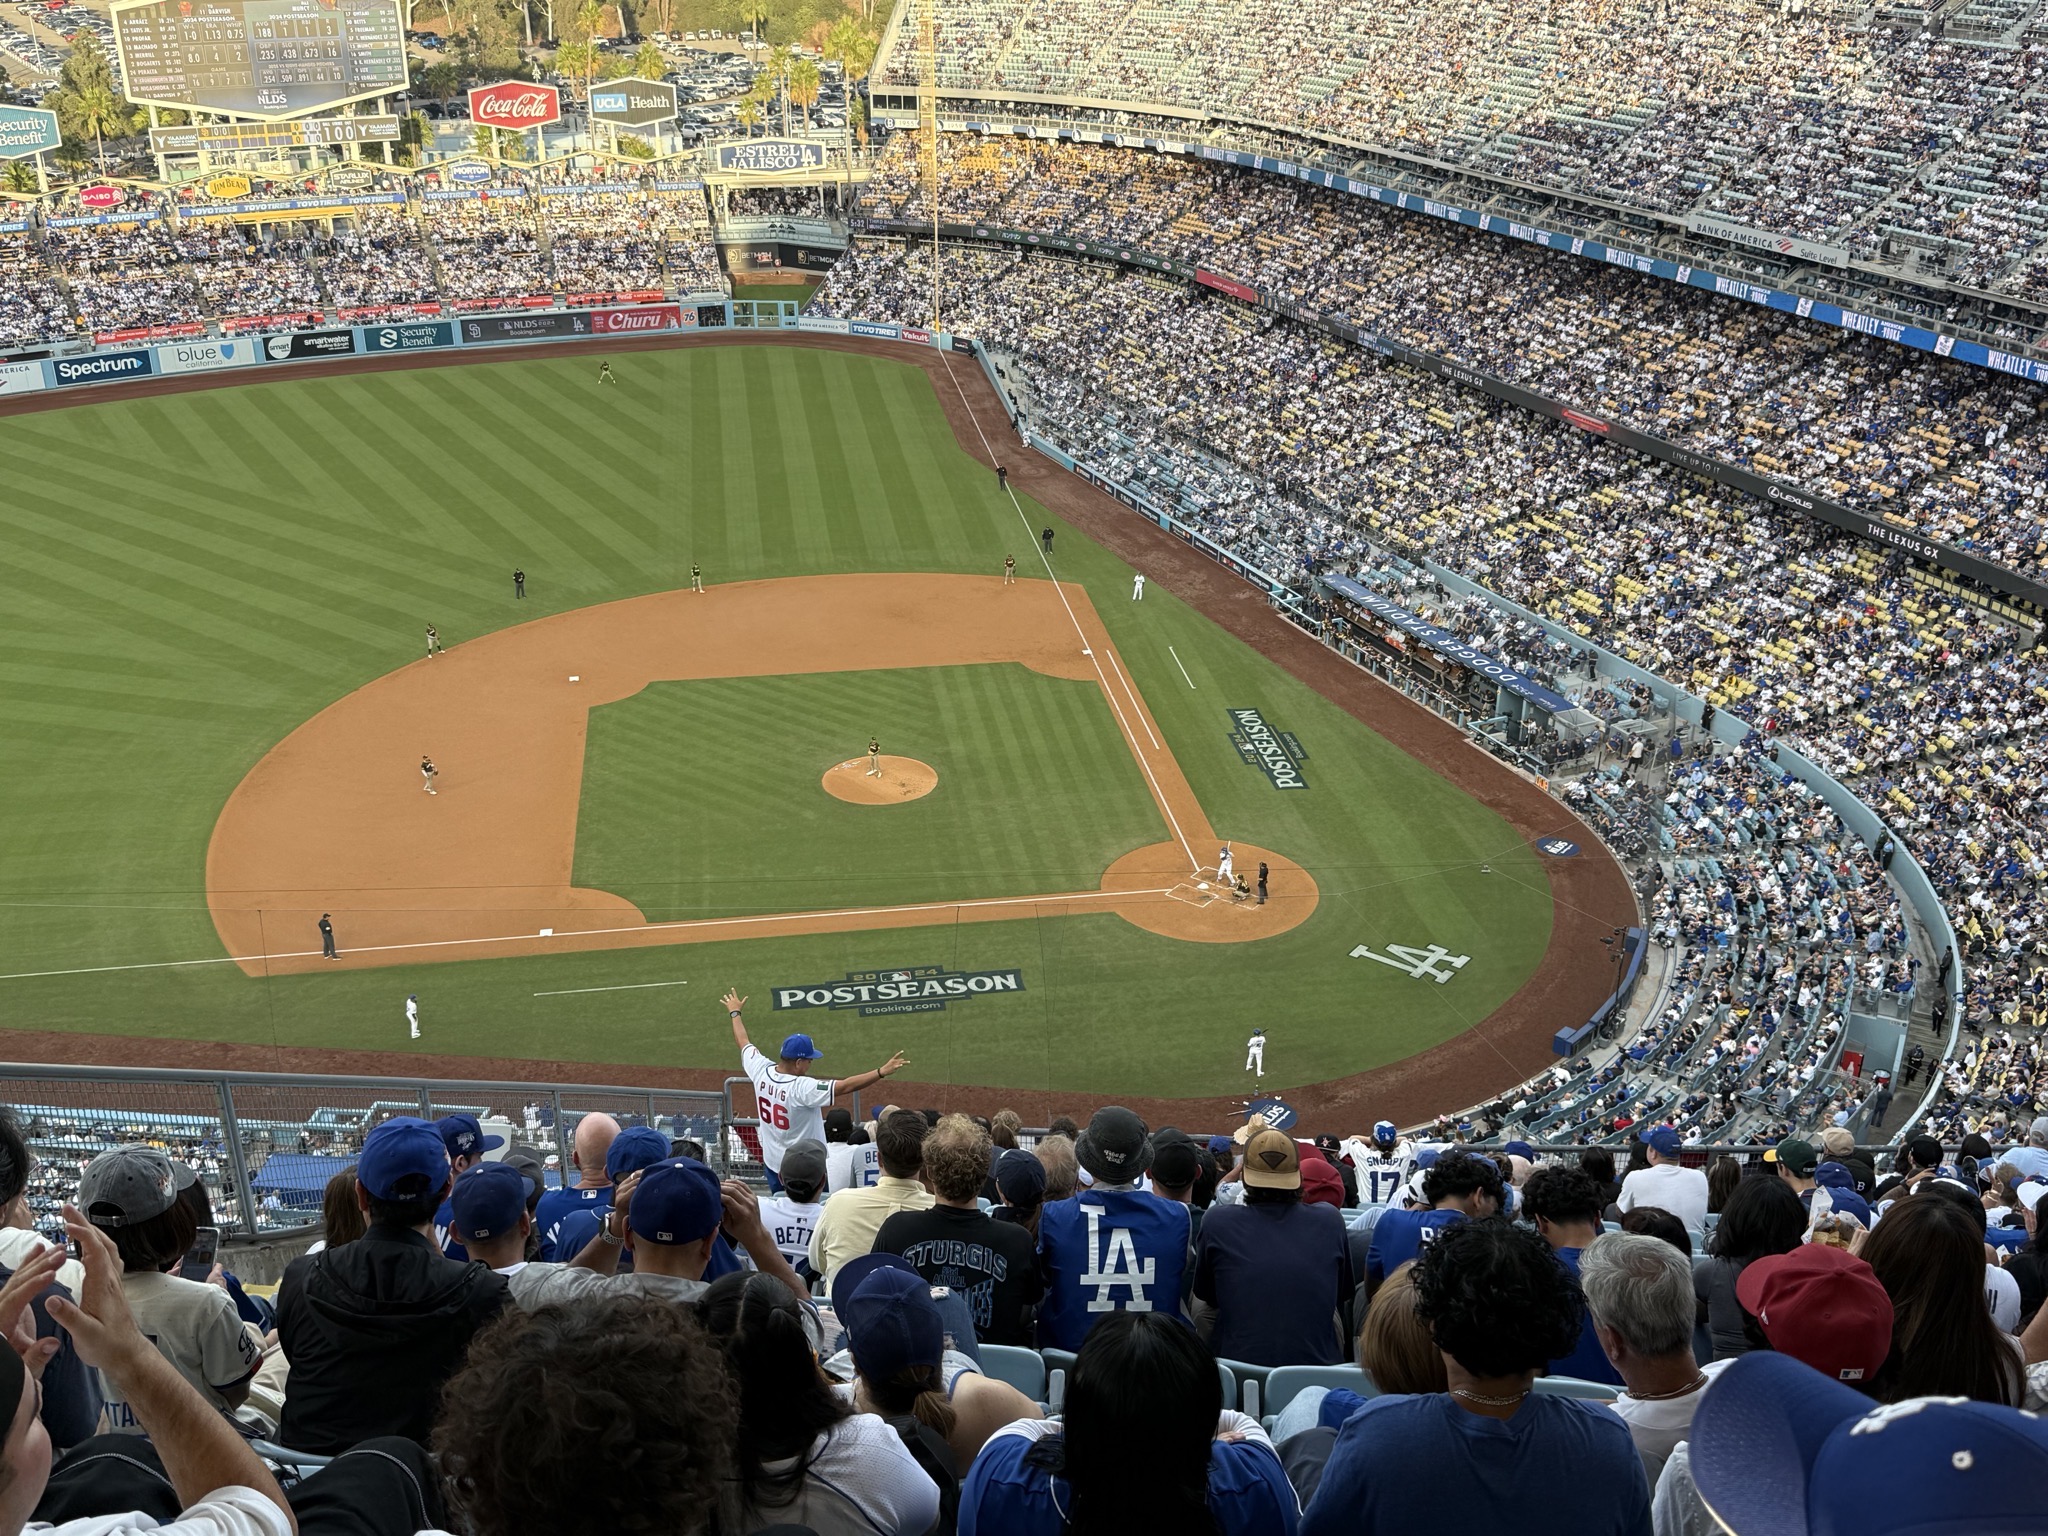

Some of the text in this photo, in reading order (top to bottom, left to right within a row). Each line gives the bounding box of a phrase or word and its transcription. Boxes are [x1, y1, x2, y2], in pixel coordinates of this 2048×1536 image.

[184, 31, 196, 40] 1-0
[205, 30, 221, 39] 1.13
[228, 30, 244, 38] 0.75
[256, 28, 272, 38] .188
[284, 28, 287, 36] 1
[306, 27, 309, 35] 1
[327, 26, 331, 35] 3
[188, 53, 200, 63] 8.0
[214, 53, 219, 62] 4
[236, 52, 241, 61] 2
[259, 50, 275, 60] .235
[281, 50, 297, 58] .438
[303, 49, 318, 58] .673
[328, 48, 336, 56] 16
[258, 95, 287, 104] NLDS
[479, 92, 548, 119] Coca-Cola
[594, 94, 670, 110] UCLA Health
[324, 126, 353, 140] 1 0 0
[729, 157, 797, 169] JALISCO
[333, 172, 370, 180] STARLUX
[453, 166, 489, 176] MORTON
[213, 179, 246, 194] JIM BEAM
[267, 202, 290, 210] TIRES
[320, 198, 342, 206] TIRES
[131, 212, 155, 220] TIRES
[214, 206, 237, 214] TIRES
[76, 217, 100, 226] TIRES
[850, 219, 864, 228] 5:32
[1510, 222, 1534, 241] WHEATLEY
[1697, 223, 1772, 249] BANK OF AMERICA
[1606, 248, 1634, 268] WHEATLEY
[1800, 249, 1837, 264] Suite Level
[1716, 277, 1748, 299] WHEATLEY
[608, 312, 661, 329] Churu
[684, 312, 695, 322] 76
[1841, 310, 1880, 335] WHEATLEY
[513, 320, 537, 328] NLDS
[573, 317, 584, 332] LA
[1881, 321, 1905, 331] AMERICAN
[401, 327, 437, 337] Security
[853, 325, 897, 337] TOYO TIRES
[902, 331, 930, 342] Yakult
[304, 336, 349, 346] smartwater
[402, 337, 434, 347] Benefit
[177, 347, 216, 362] blue
[59, 357, 139, 380] Spectrum
[1987, 349, 2031, 377] WHEATLEY
[0, 366, 30, 374] MERICA
[1441, 364, 1452, 376] THE
[1454, 370, 1472, 382] LEXUS
[1672, 451, 1687, 463] LIVE
[1689, 457, 1700, 467] UP
[1702, 462, 1711, 471] TO
[1780, 492, 1813, 510] LEXUS
[1868, 524, 1939, 558] THE LEXUS GX
[1360, 595, 1518, 682] DODGER STADIUM
[1234, 710, 1304, 788] POSTSEASON
[1348, 943, 1472, 985] LA
[779, 974, 1018, 1008] POSTSEASON
[865, 1001, 940, 1014] Booking.com
[760, 1080, 786, 1102] PUIG
[758, 1096, 790, 1131] 66
[1367, 1156, 1404, 1168] SNOOPY
[1369, 1171, 1401, 1204] 17
[776, 1226, 814, 1246] BETT
[902, 1240, 1008, 1282] STURGIS
[1079, 1204, 1155, 1312] LA
[933, 1274, 966, 1288] ANNUAL
